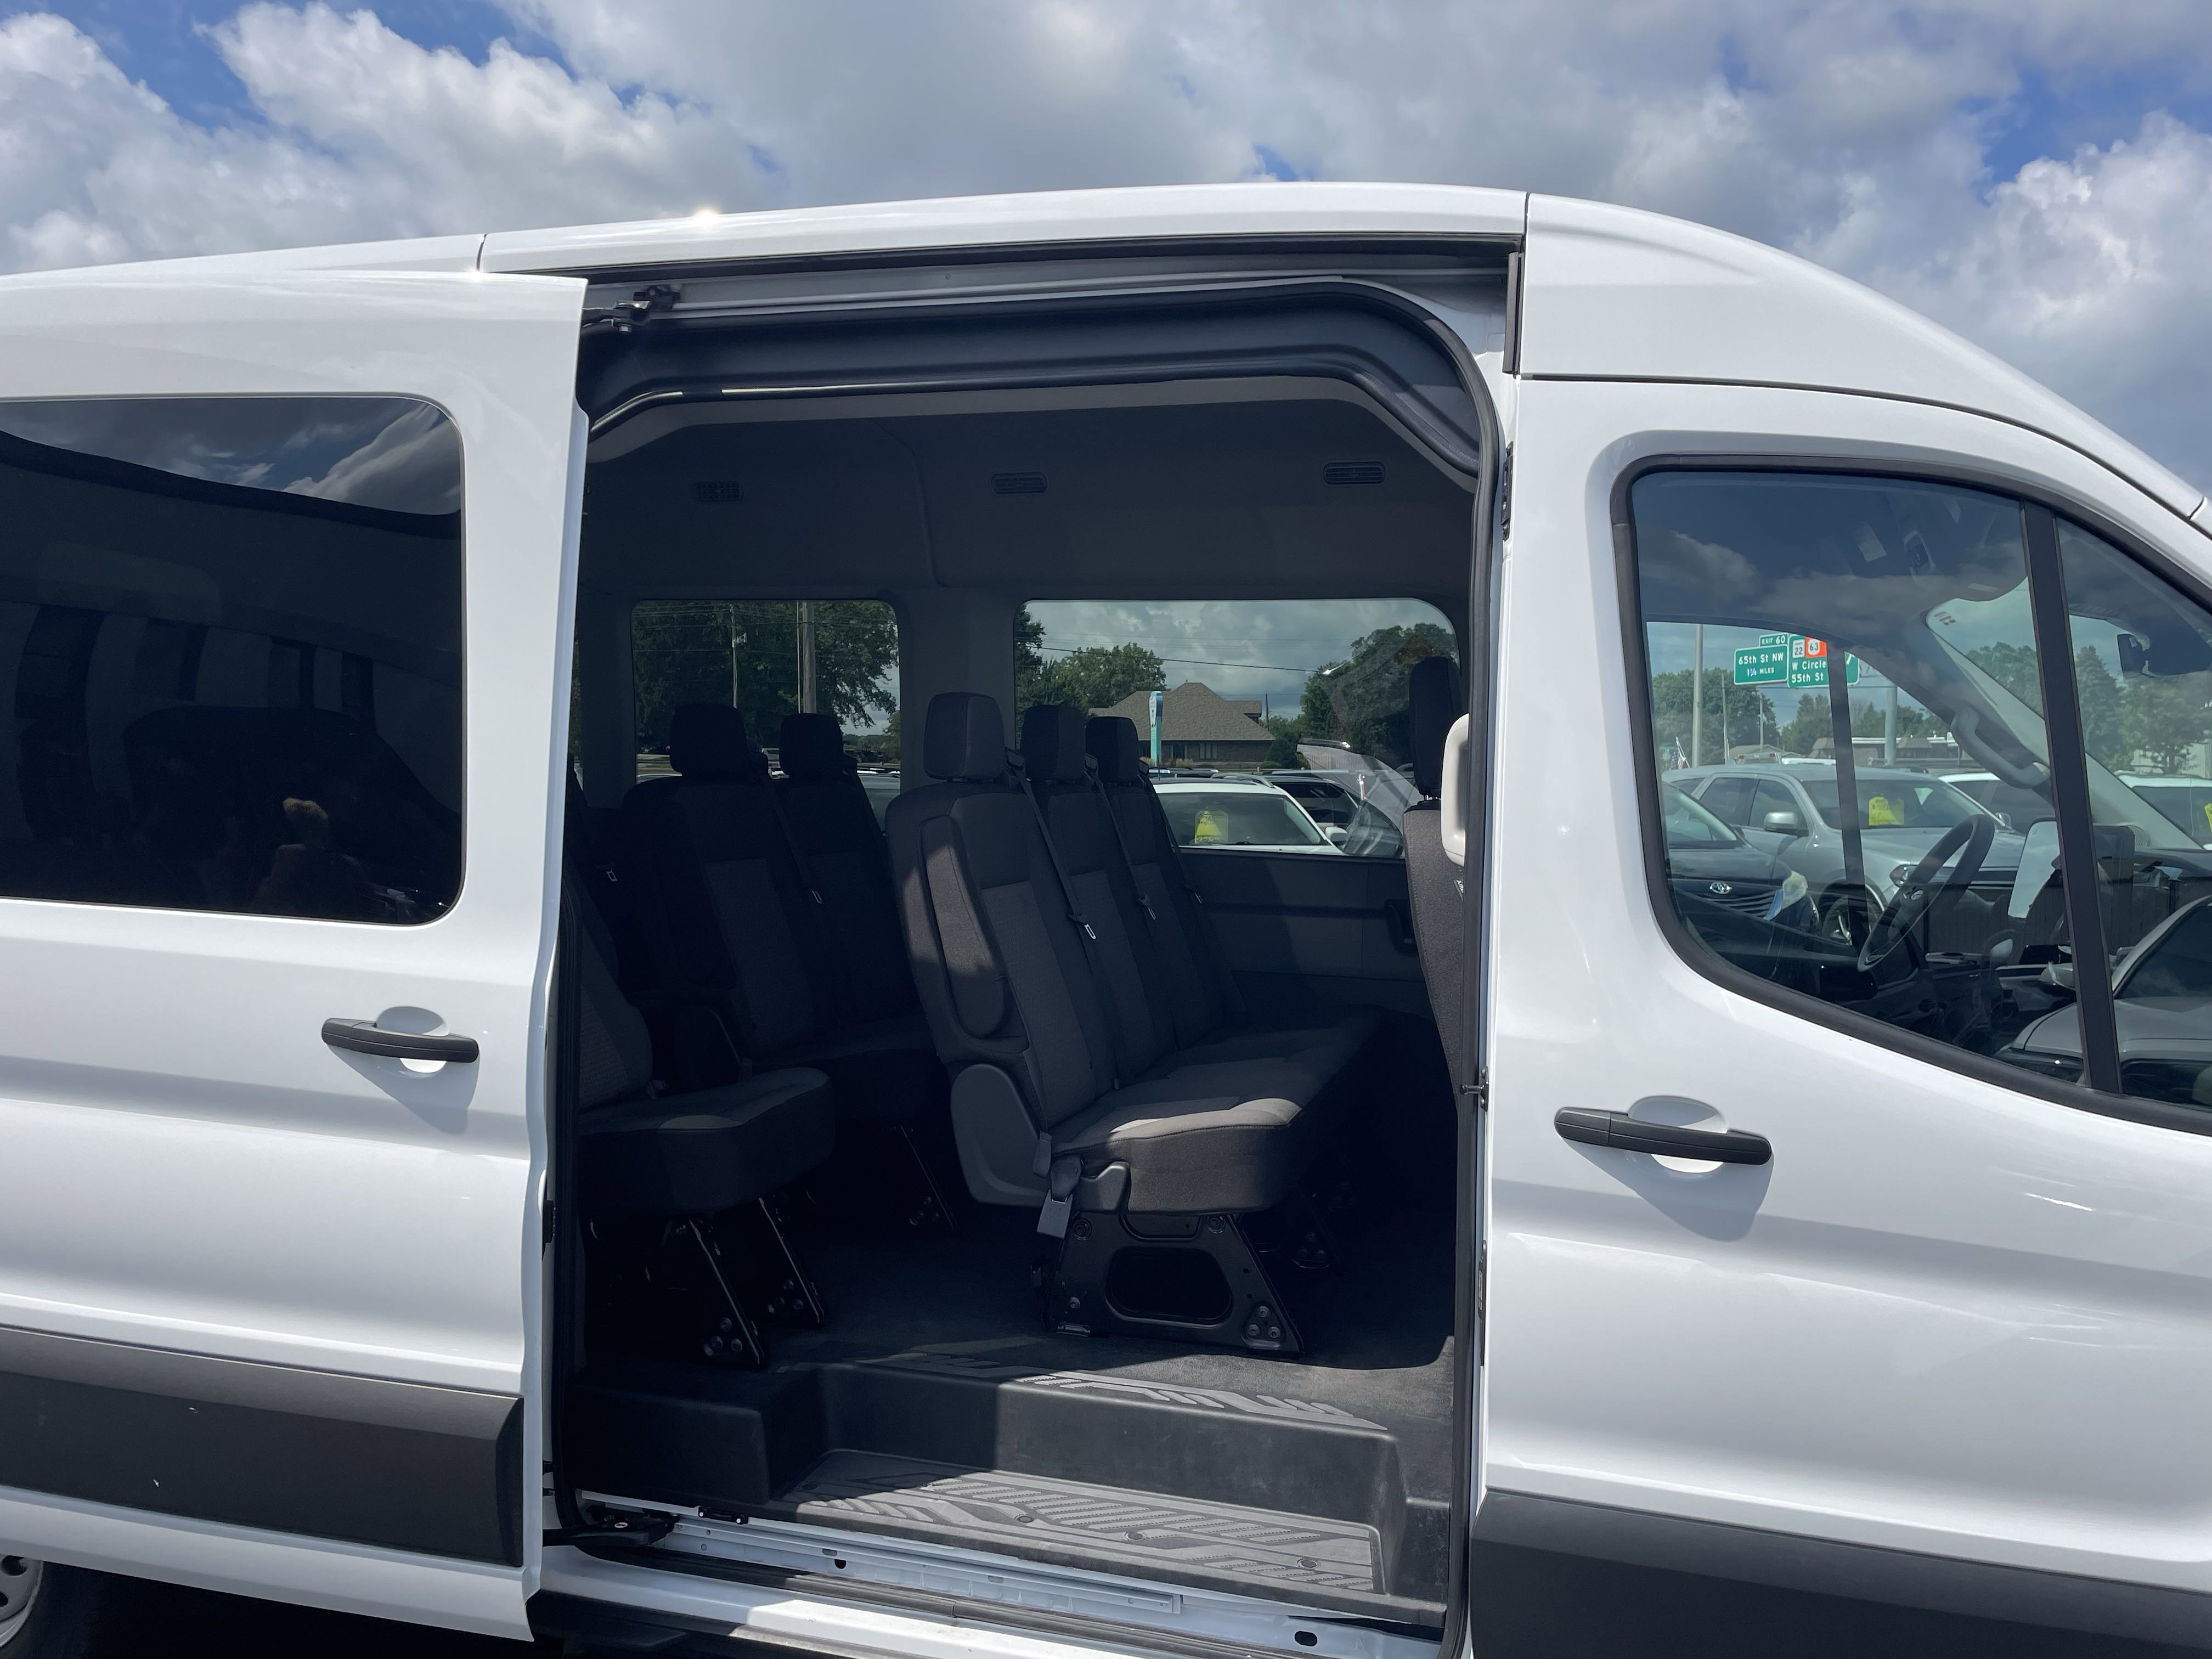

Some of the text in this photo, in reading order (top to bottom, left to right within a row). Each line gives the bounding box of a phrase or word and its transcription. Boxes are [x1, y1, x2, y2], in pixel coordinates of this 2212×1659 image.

[1775, 635, 1786, 644] 60
[1795, 647, 1803, 655] 22
[1809, 642, 1819, 651] 63
[1739, 652, 1784, 665] 65th St NW
[1792, 659, 1826, 671] W Circle
[1791, 672, 1824, 684] 55th St
